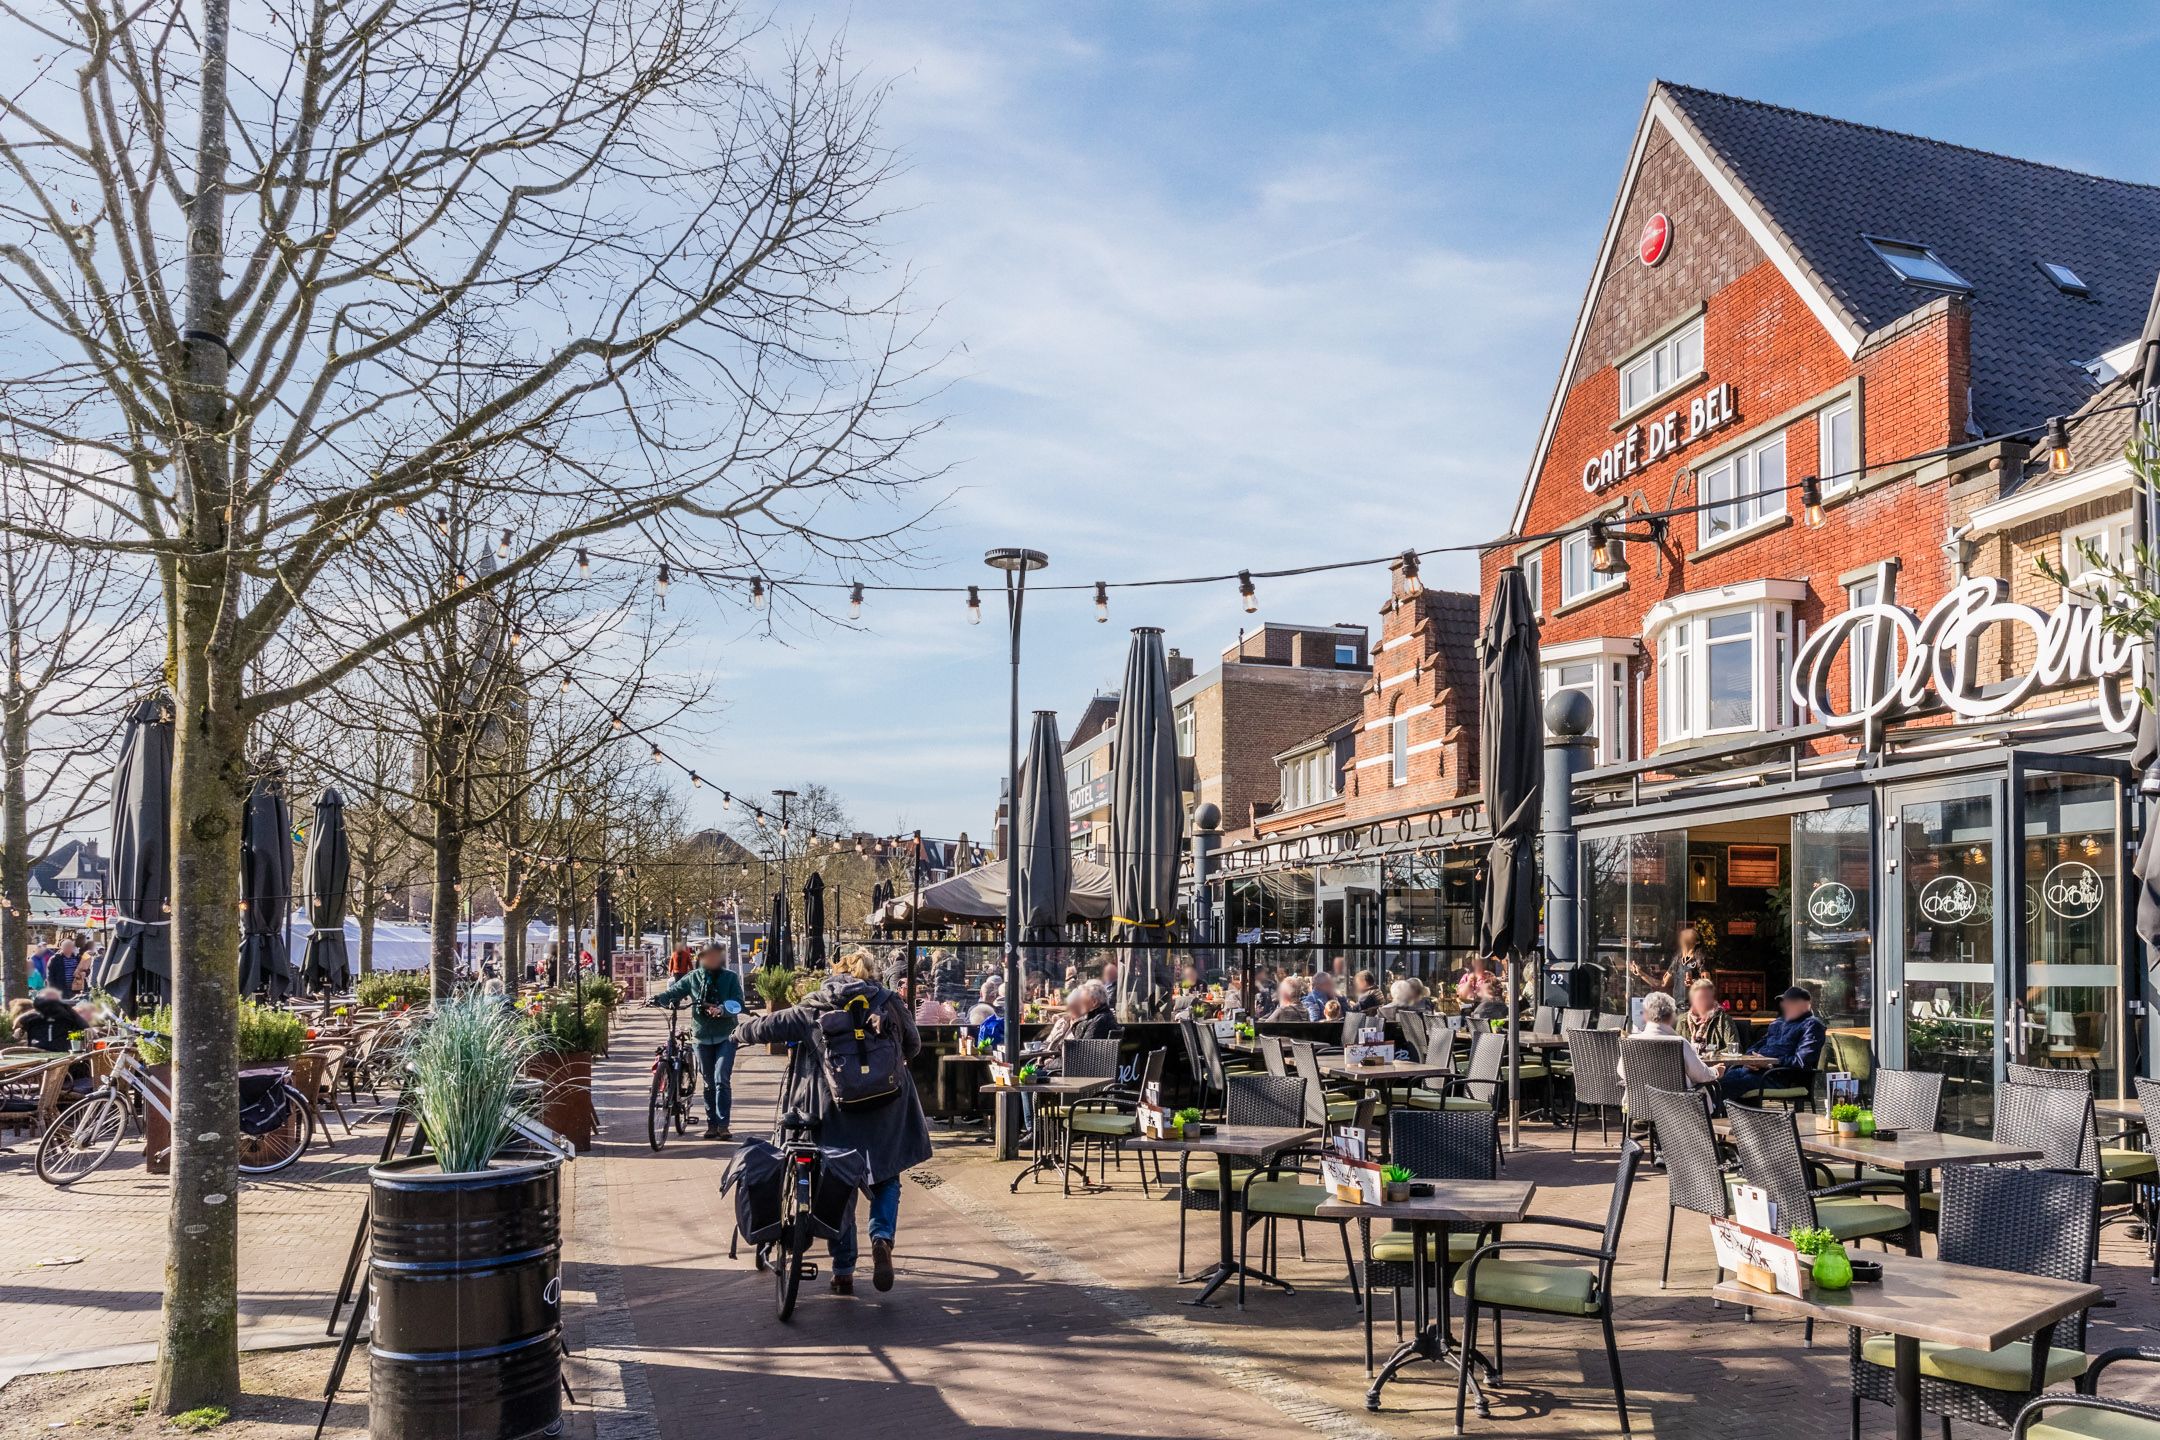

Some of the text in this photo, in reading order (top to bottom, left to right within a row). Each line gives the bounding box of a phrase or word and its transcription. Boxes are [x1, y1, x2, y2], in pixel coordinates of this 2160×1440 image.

[1583, 383, 1734, 493] CAFÉ DE BEL
[1790, 561, 1930, 753] De
[1070, 785, 1094, 811] HOTEL
[1924, 890, 1943, 916] De
[2048, 879, 2068, 909] De
[1550, 973, 1564, 985] 22
